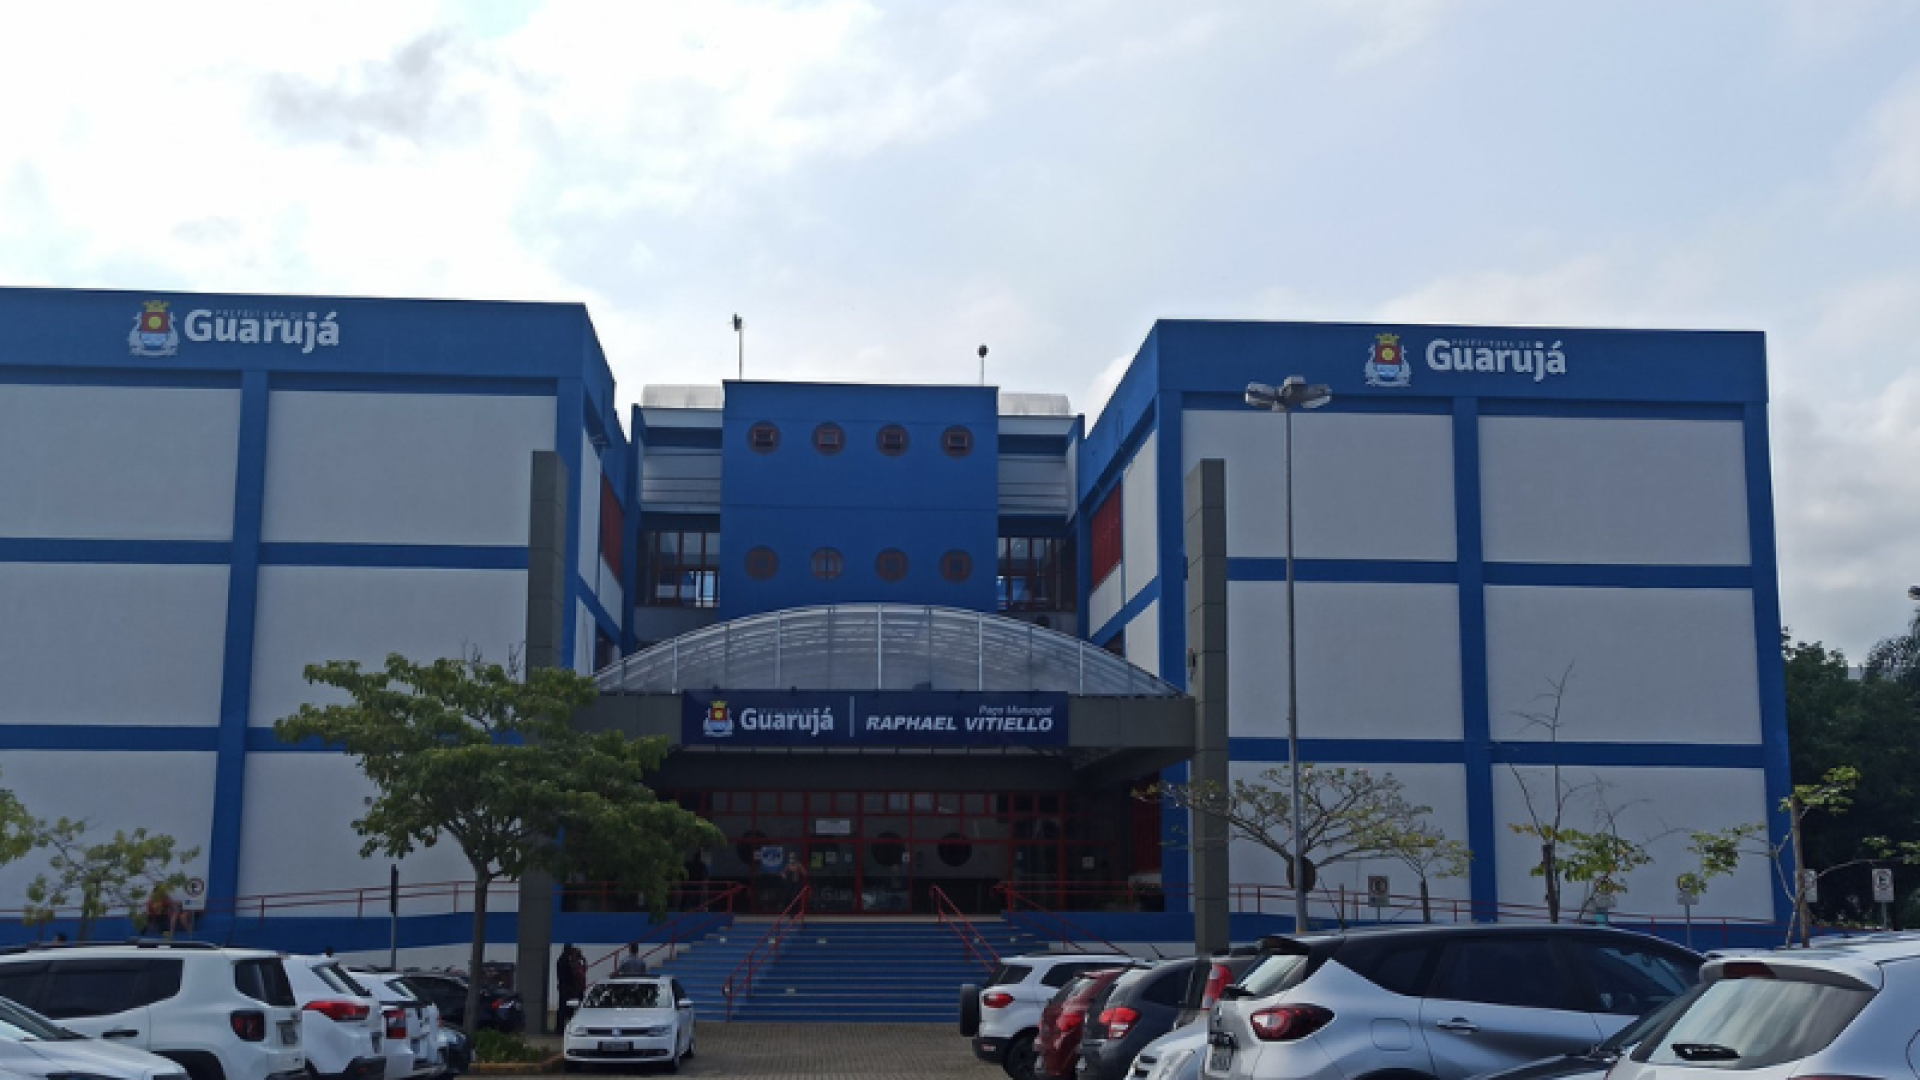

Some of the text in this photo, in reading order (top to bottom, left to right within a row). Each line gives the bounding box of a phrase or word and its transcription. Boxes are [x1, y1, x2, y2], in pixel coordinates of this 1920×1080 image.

[185, 309, 339, 354] Guarujá
[1426, 338, 1566, 382] Guarujá
[741, 706, 834, 737] Guarujá
[866, 714, 1054, 732] RAPHAEL VITIELLO
